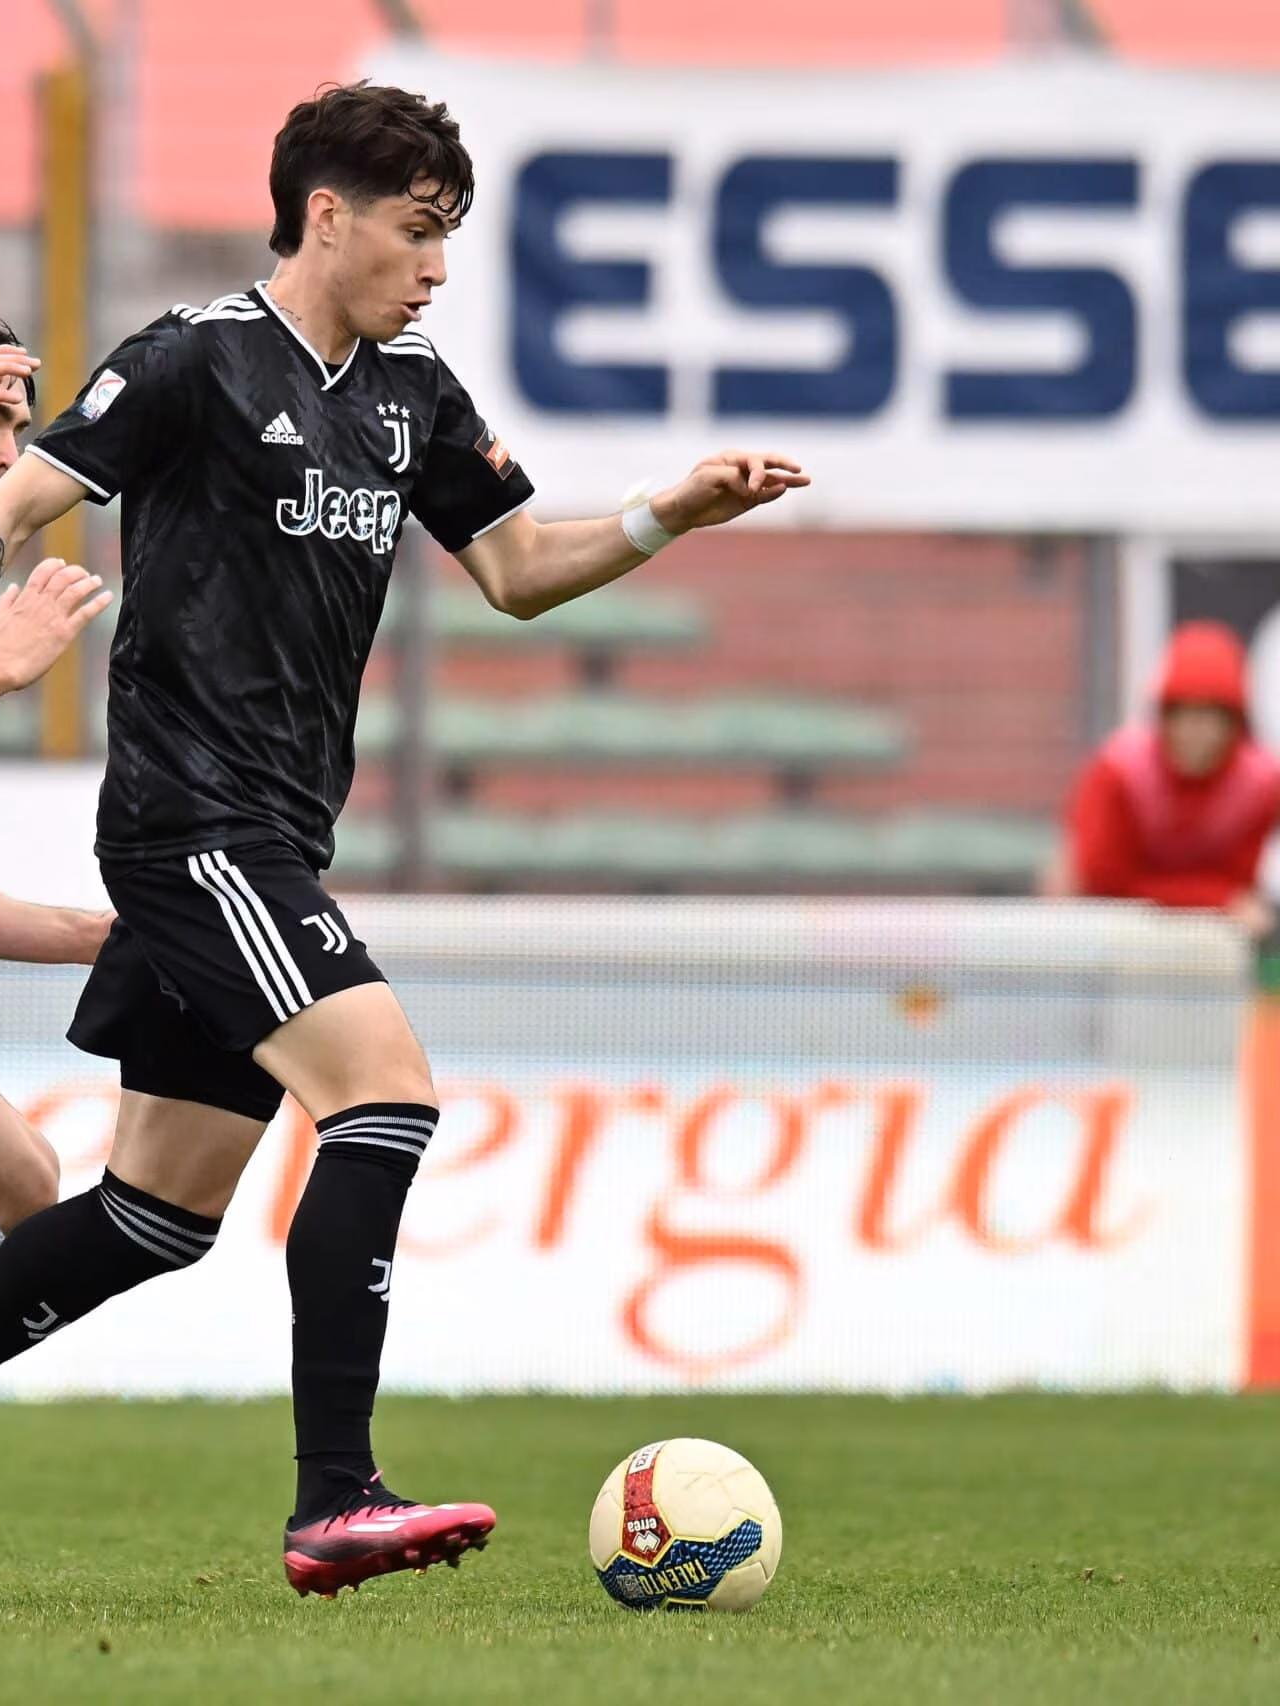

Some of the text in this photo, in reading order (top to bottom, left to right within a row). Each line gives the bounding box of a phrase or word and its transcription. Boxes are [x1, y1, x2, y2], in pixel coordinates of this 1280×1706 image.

[260, 431, 305, 446] adidas
[275, 467, 402, 555] Jeep
[637, 1557, 712, 1597] TALENTO
